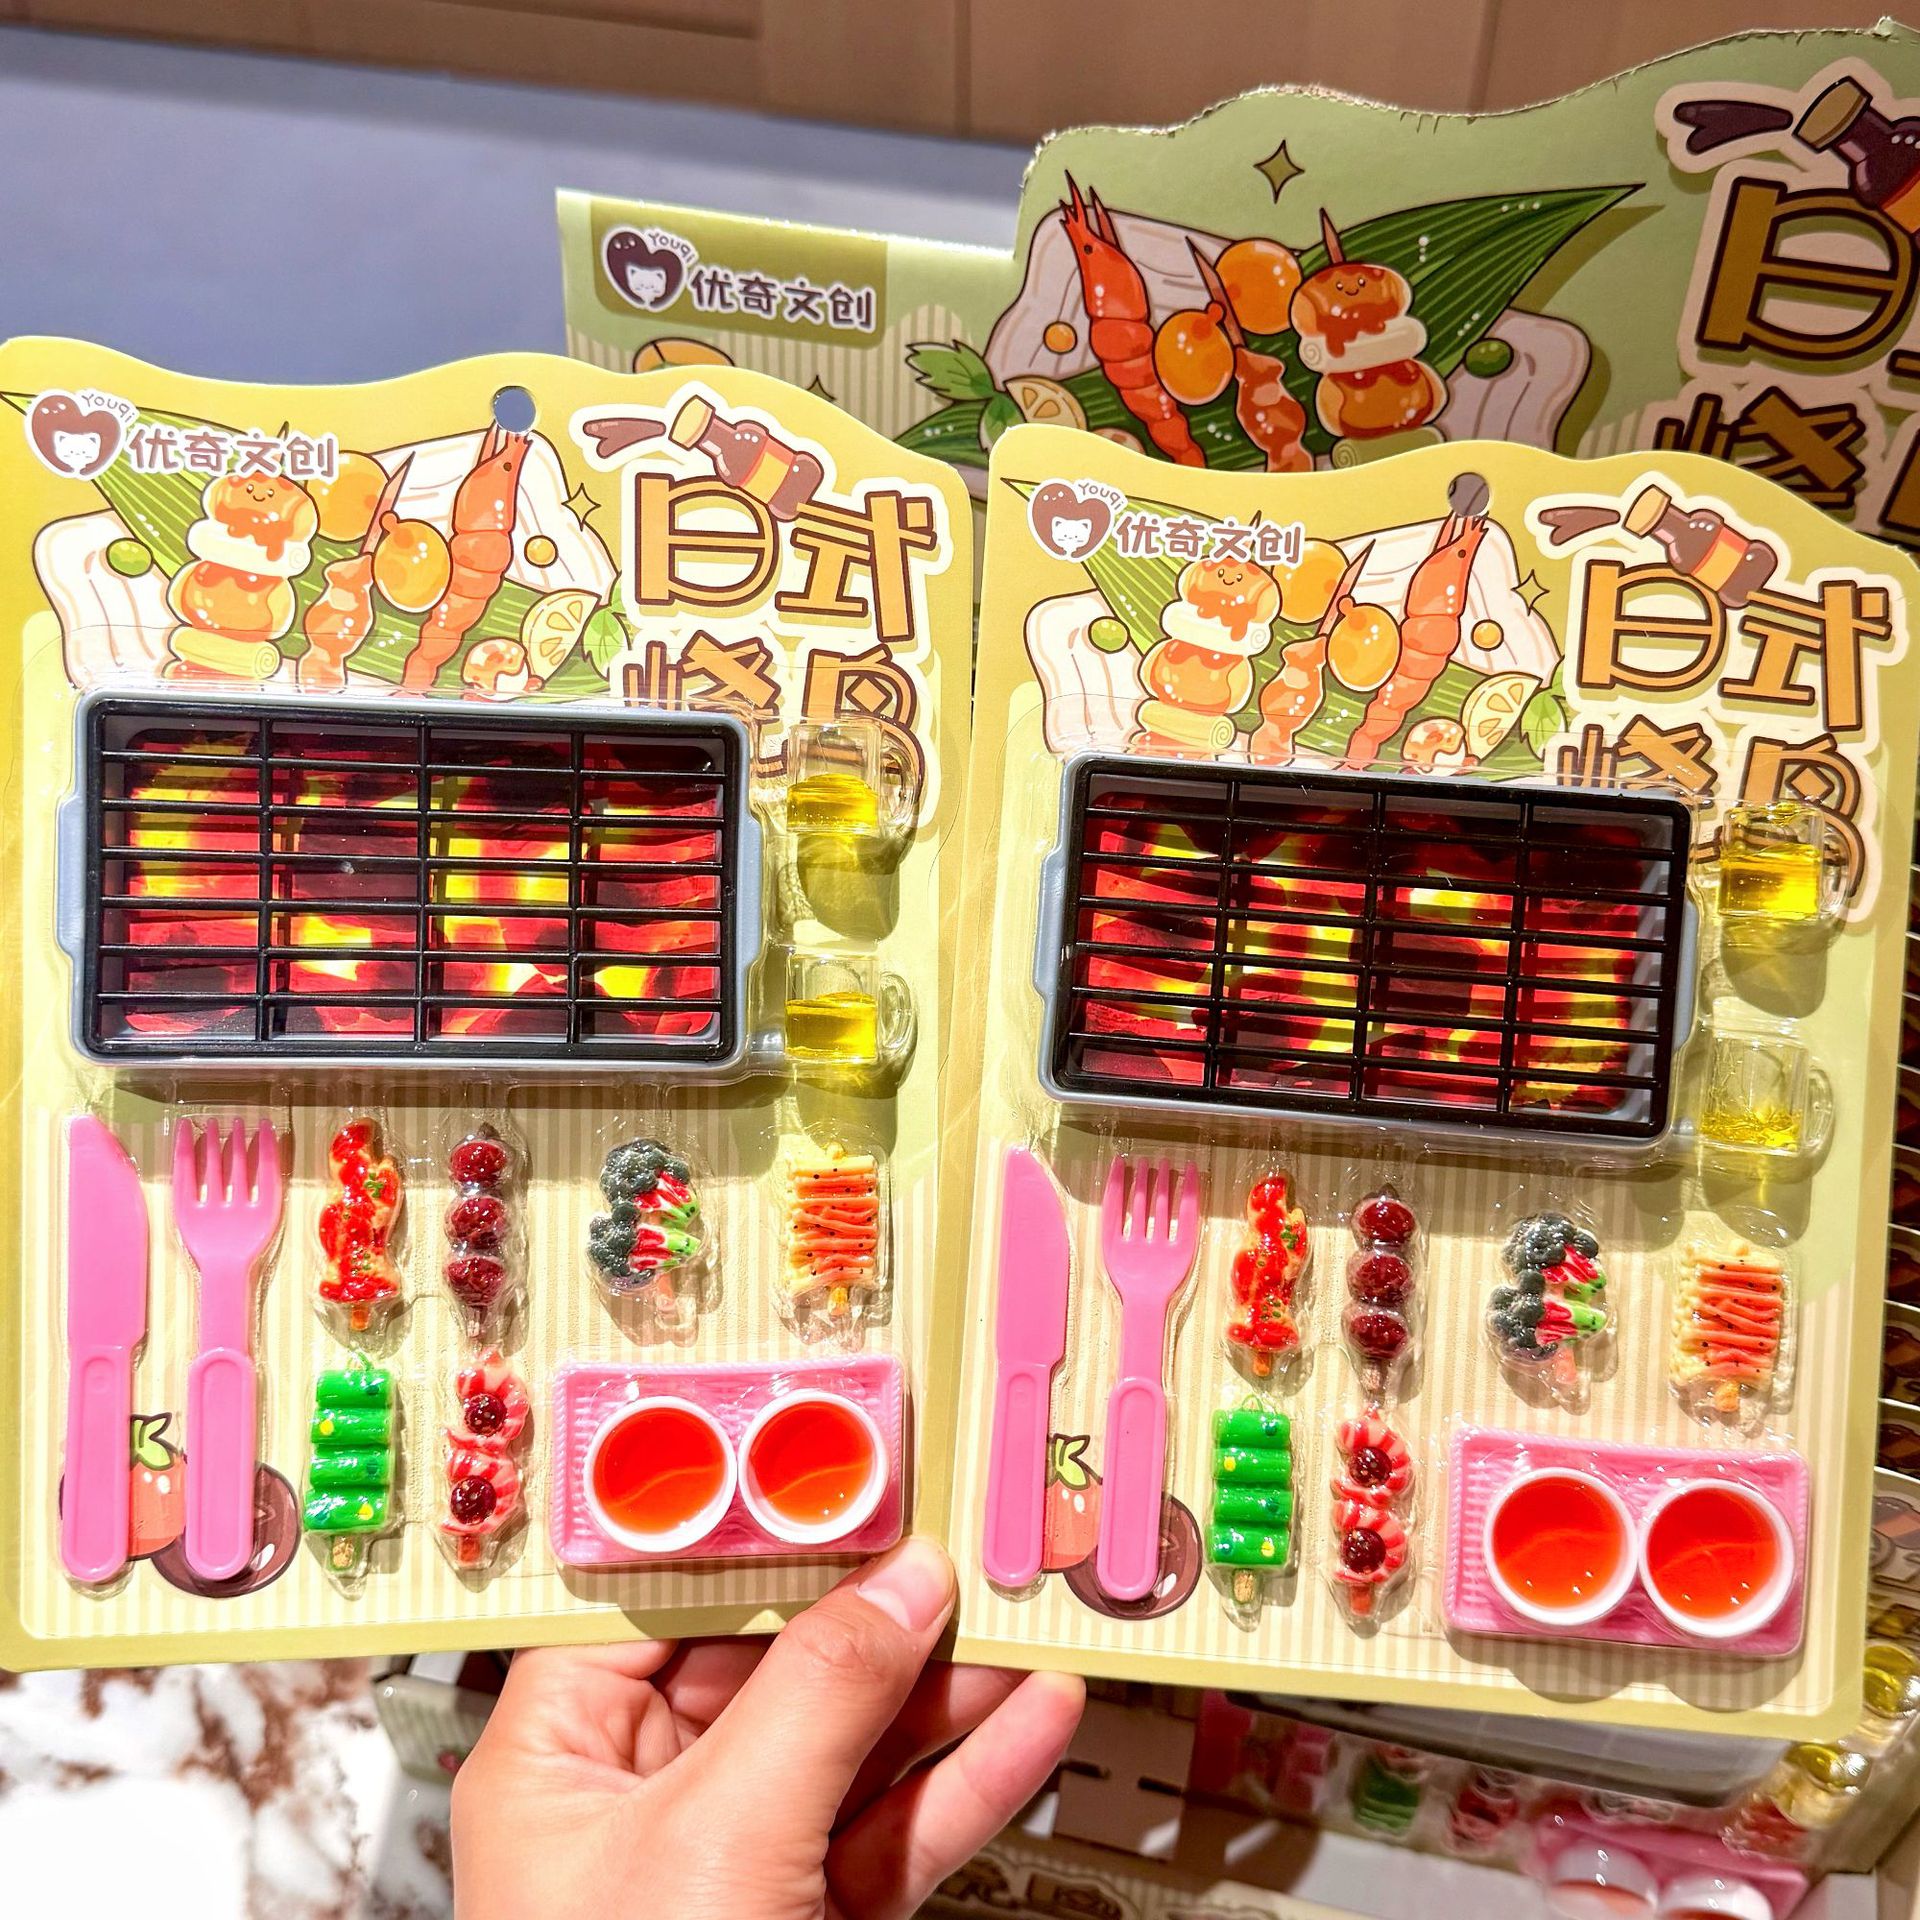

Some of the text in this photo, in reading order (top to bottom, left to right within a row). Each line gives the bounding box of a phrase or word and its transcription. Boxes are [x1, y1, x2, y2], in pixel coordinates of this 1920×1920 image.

[691, 268, 875, 329] 优奇文创
[1696, 175, 1920, 374] 日
[129, 427, 335, 477] 优奇文创
[635, 472, 937, 642] 日式
[1117, 514, 1303, 563] 优奇文创
[1576, 560, 1892, 732] 日式
